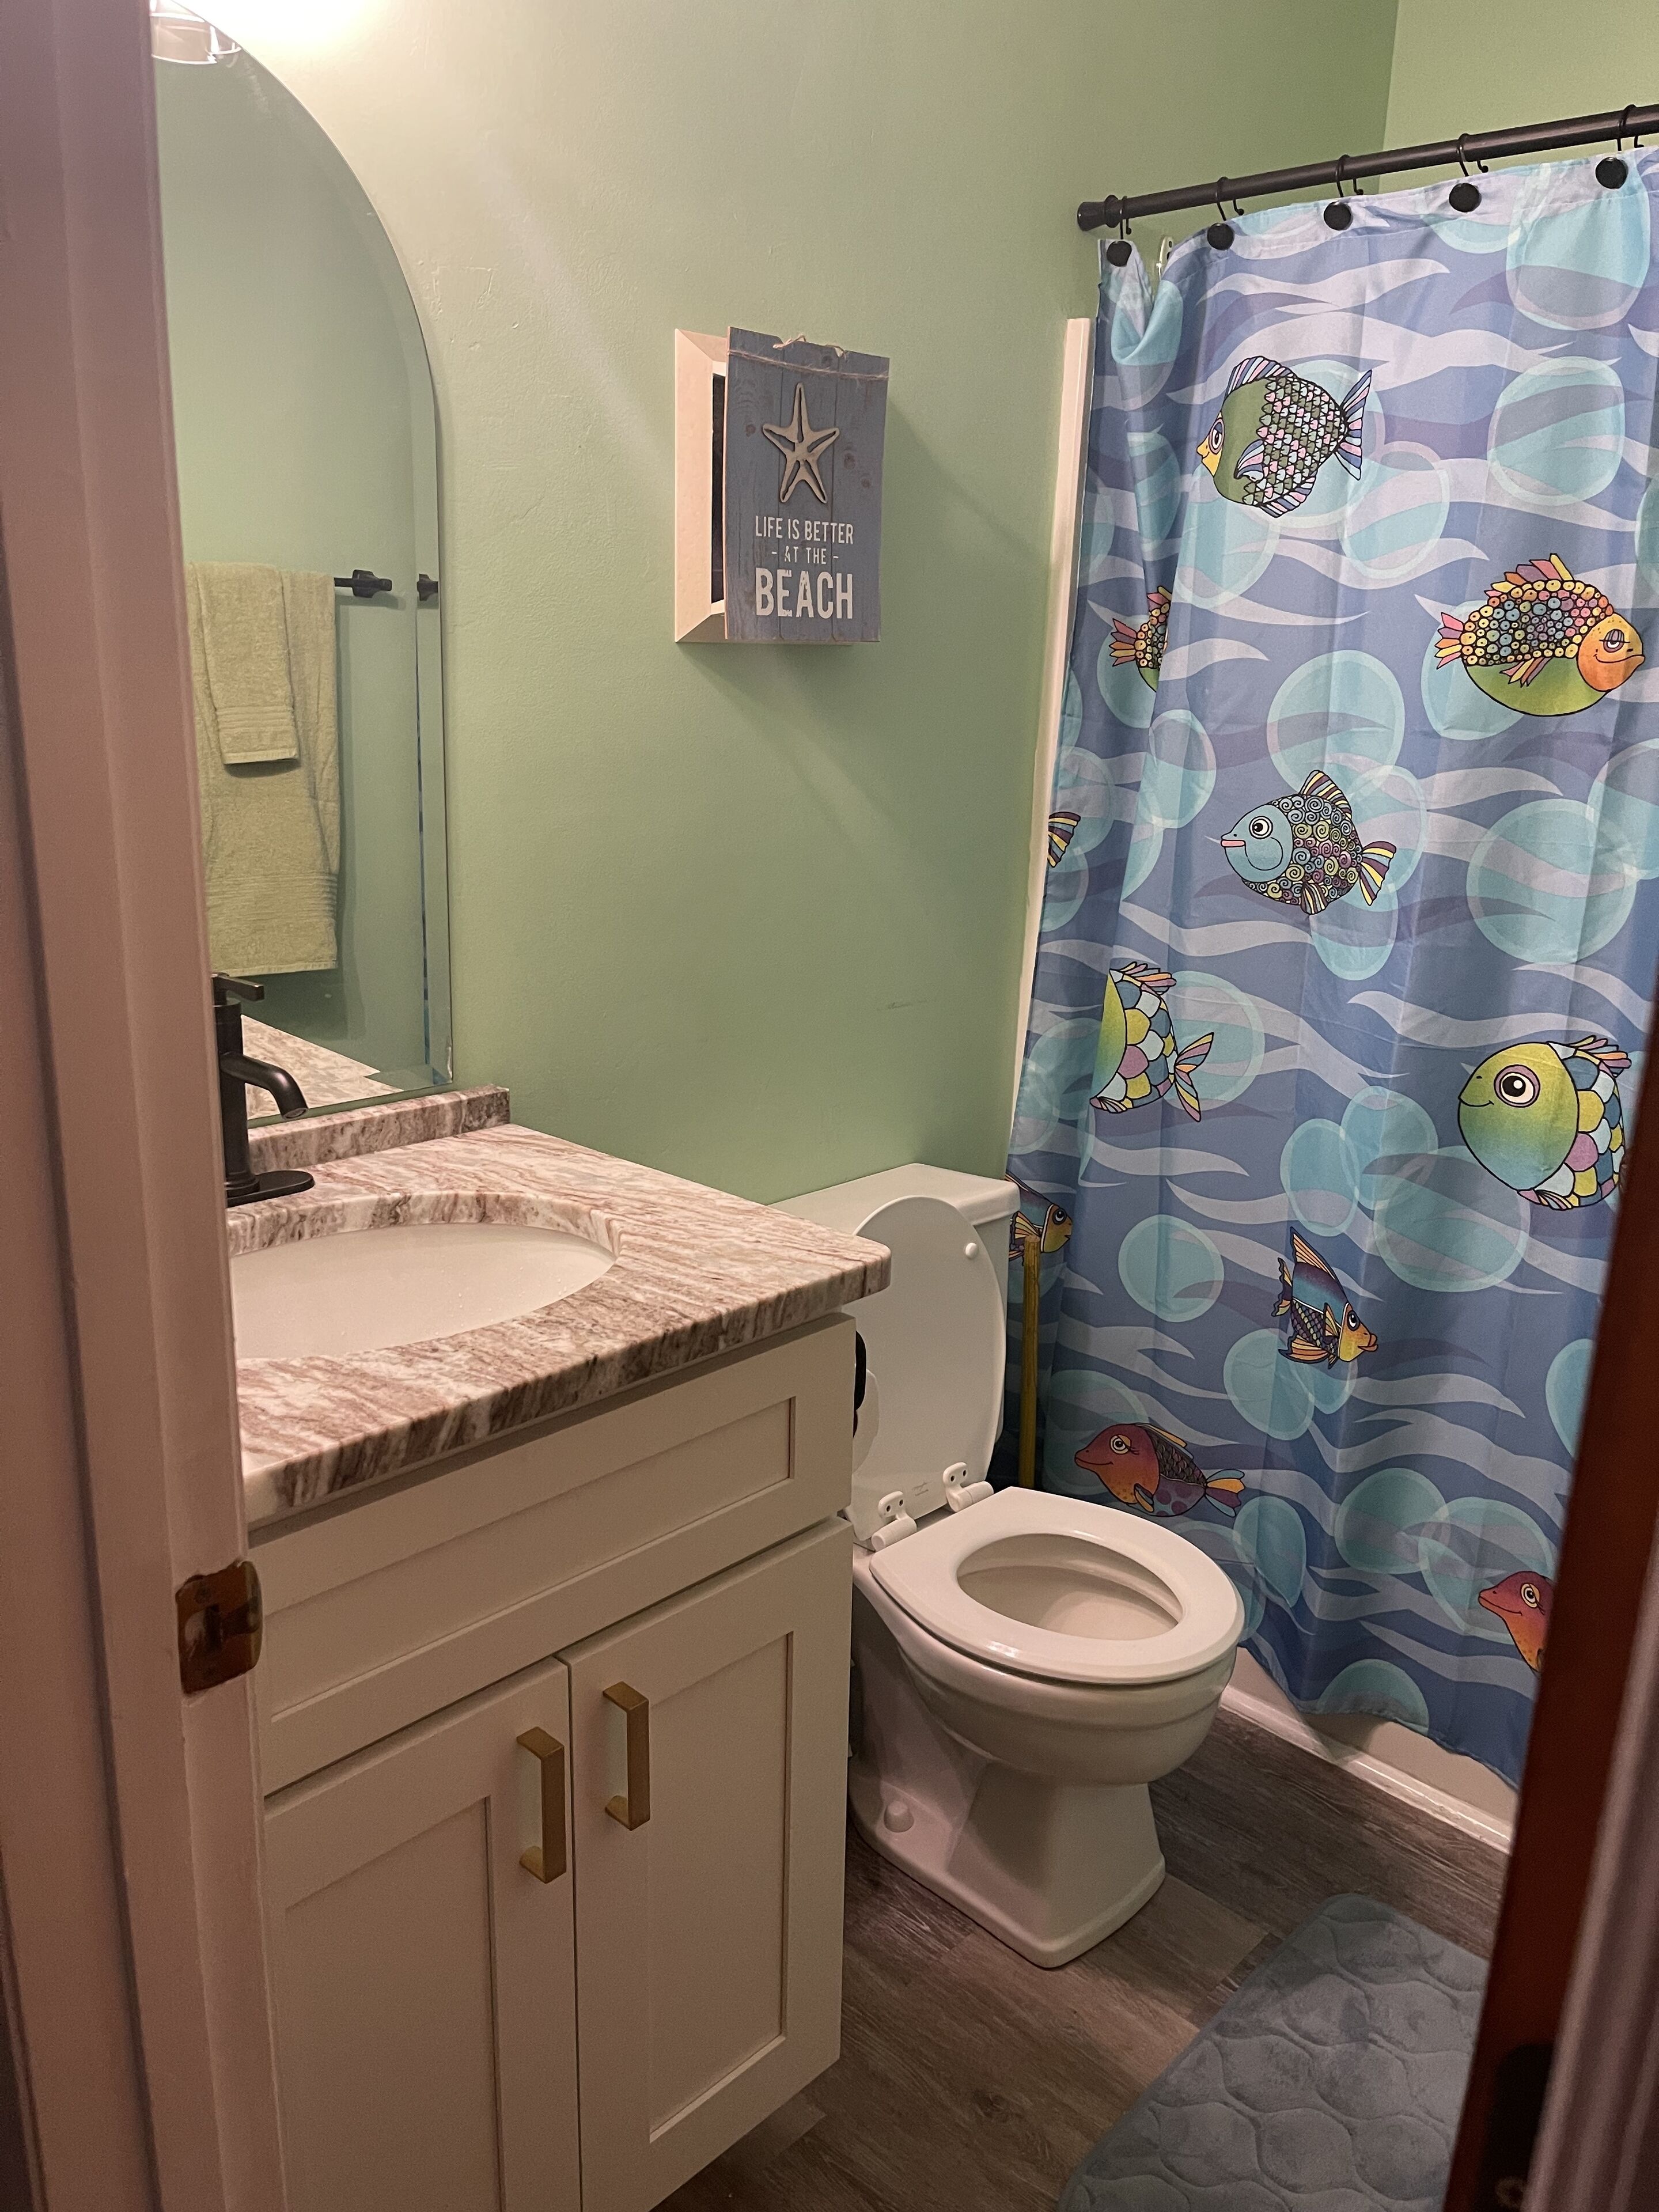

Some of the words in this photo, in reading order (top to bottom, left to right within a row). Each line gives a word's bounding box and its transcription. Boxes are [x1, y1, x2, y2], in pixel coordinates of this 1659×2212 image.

[756, 515, 783, 539] LIFE
[788, 518, 800, 540] IS
[805, 520, 854, 544] BETTER
[784, 546, 799, 563] AT
[806, 547, 827, 565] THE
[755, 567, 853, 619] BEACH
